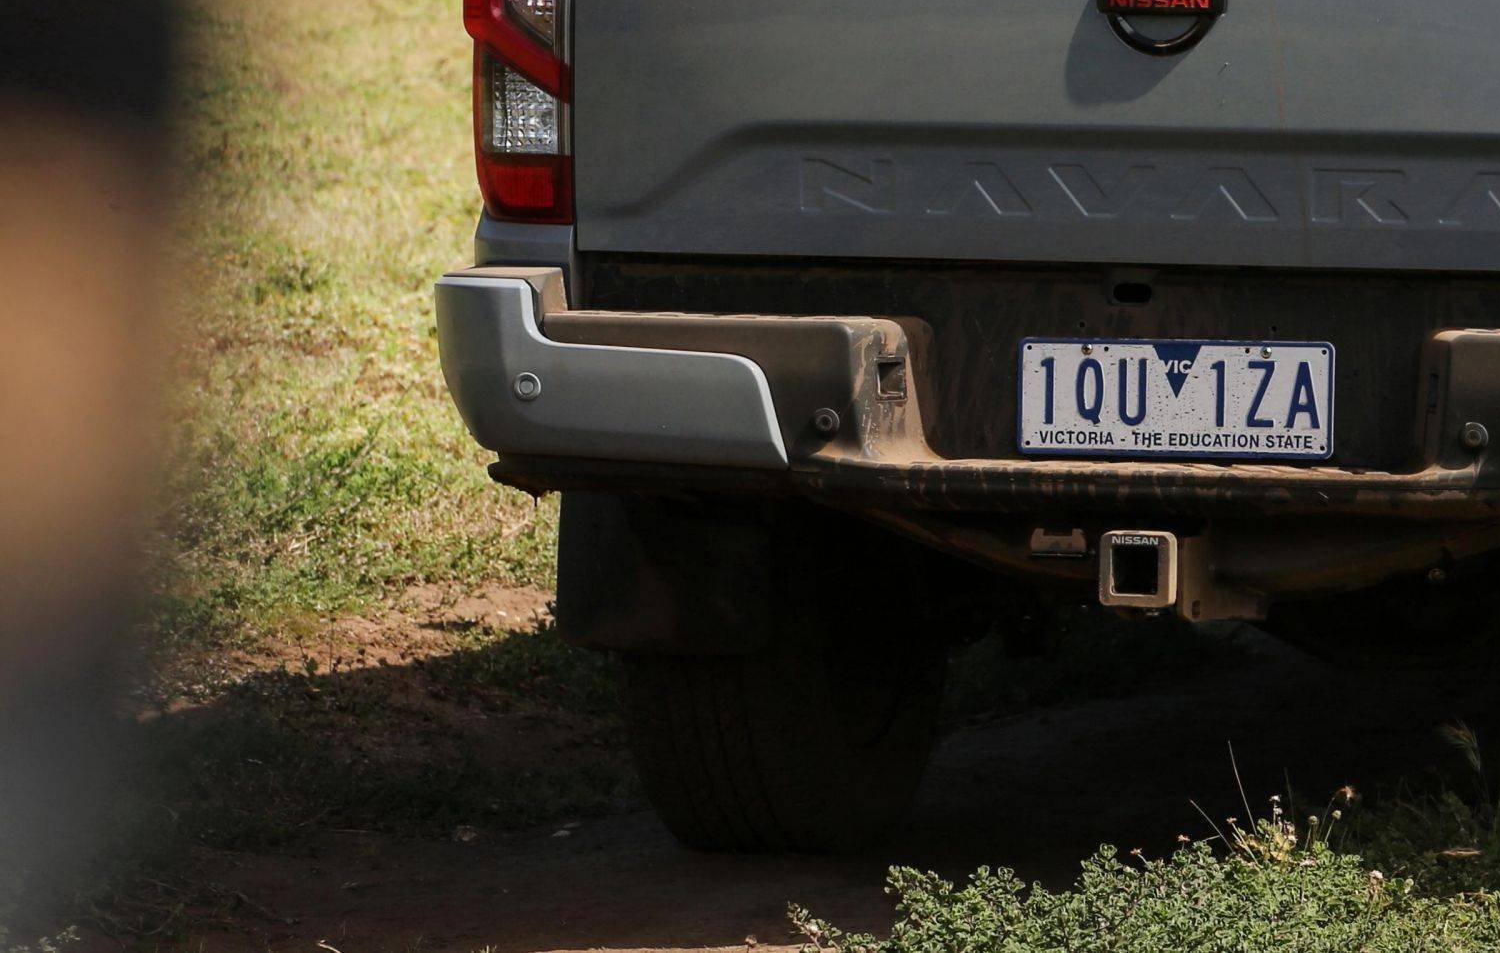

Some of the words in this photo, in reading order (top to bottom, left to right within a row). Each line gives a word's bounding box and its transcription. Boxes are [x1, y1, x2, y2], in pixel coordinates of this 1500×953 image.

[1163, 359, 1192, 375] VIC
[1040, 356, 1148, 426] 1QU
[1210, 360, 1321, 429] 1ZA
[1039, 430, 1114, 445] VICTORIA
[1133, 432, 1162, 447] THE
[1168, 433, 1259, 448] EDUCATION
[1265, 434, 1313, 449] STATE
[1111, 535, 1159, 546] NISSAN
